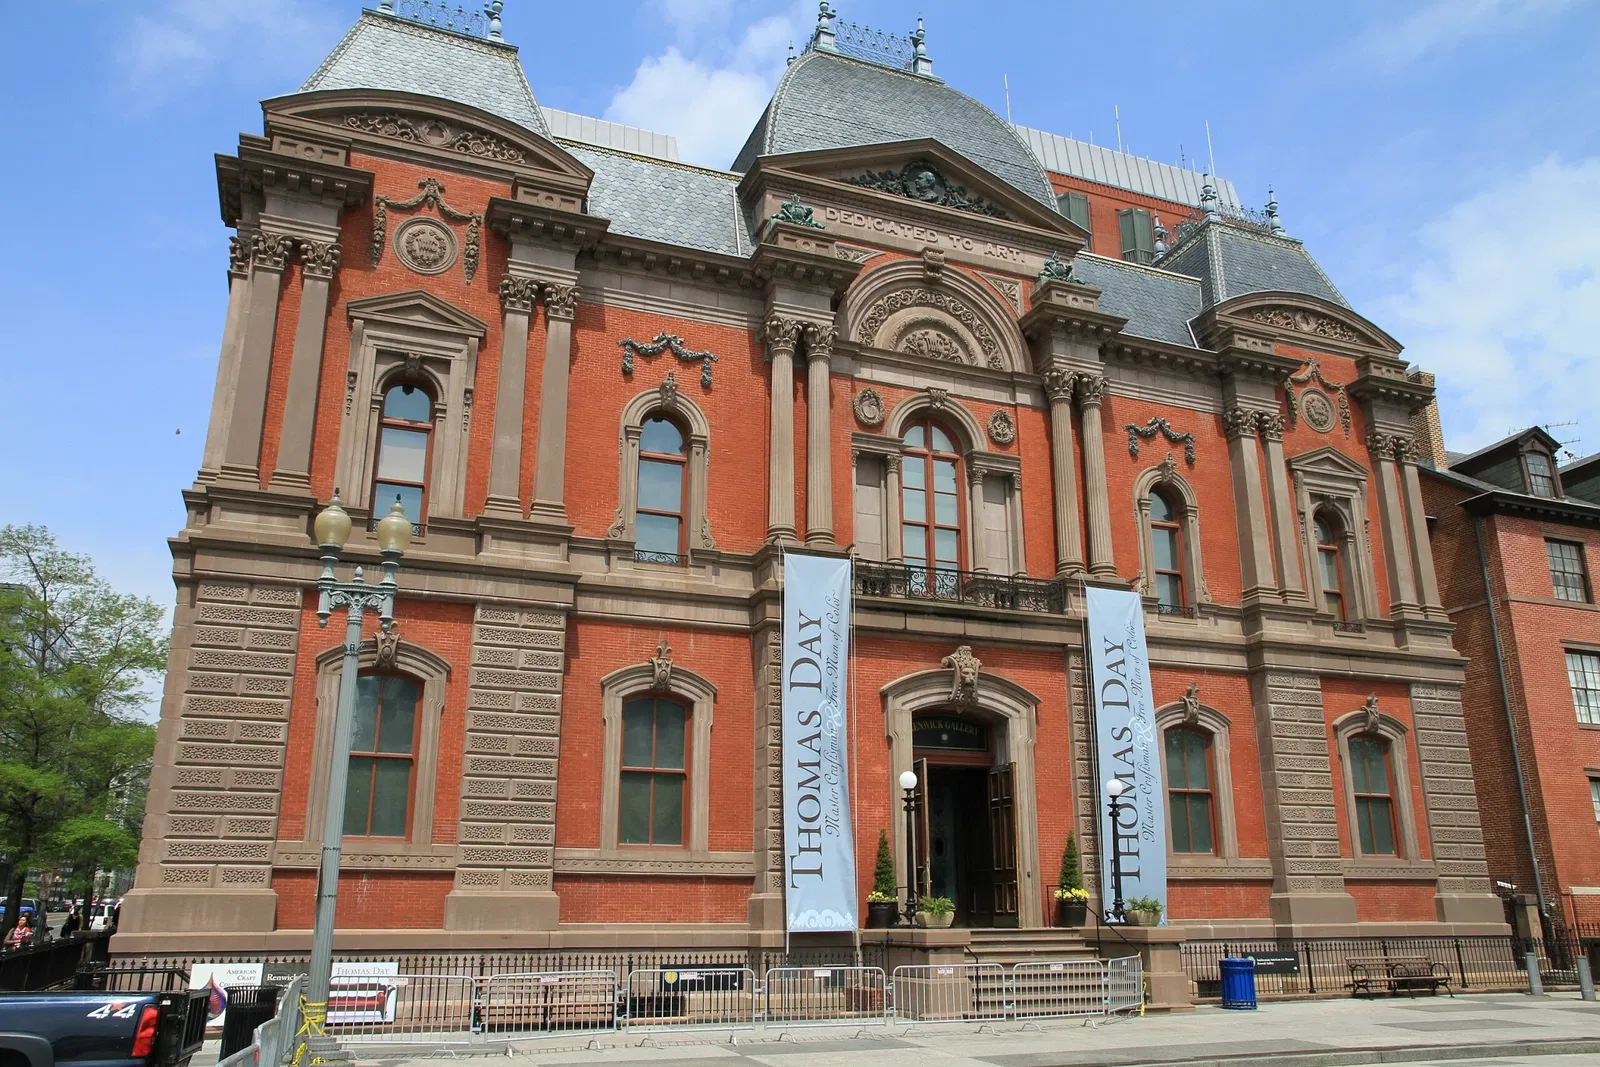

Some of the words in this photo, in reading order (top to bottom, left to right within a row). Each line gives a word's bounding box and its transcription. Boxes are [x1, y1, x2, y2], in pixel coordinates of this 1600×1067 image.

[824, 206, 939, 244] DEDICATED
[949, 234, 975, 252] TO
[984, 243, 1026, 264] ART.
[824, 590, 842, 625] Color
[789, 608, 823, 693] DAY
[834, 626, 844, 643] of
[1123, 619, 1139, 650] Color
[826, 644, 840, 678] Man
[1101, 635, 1131, 712] DAY
[1133, 650, 1144, 666] of
[825, 685, 841, 708] Free
[1131, 668, 1145, 699] Man
[912, 719, 944, 732] ENWICK
[1132, 700, 1148, 724] Free
[823, 727, 844, 786] Craftsman
[1136, 742, 1159, 796] Craftsman
[789, 709, 824, 889] THOMAS
[824, 789, 841, 838] Master
[1140, 797, 1156, 843] Master
[335, 966, 371, 975] THOMAS
[372, 966, 390, 975] DAY
